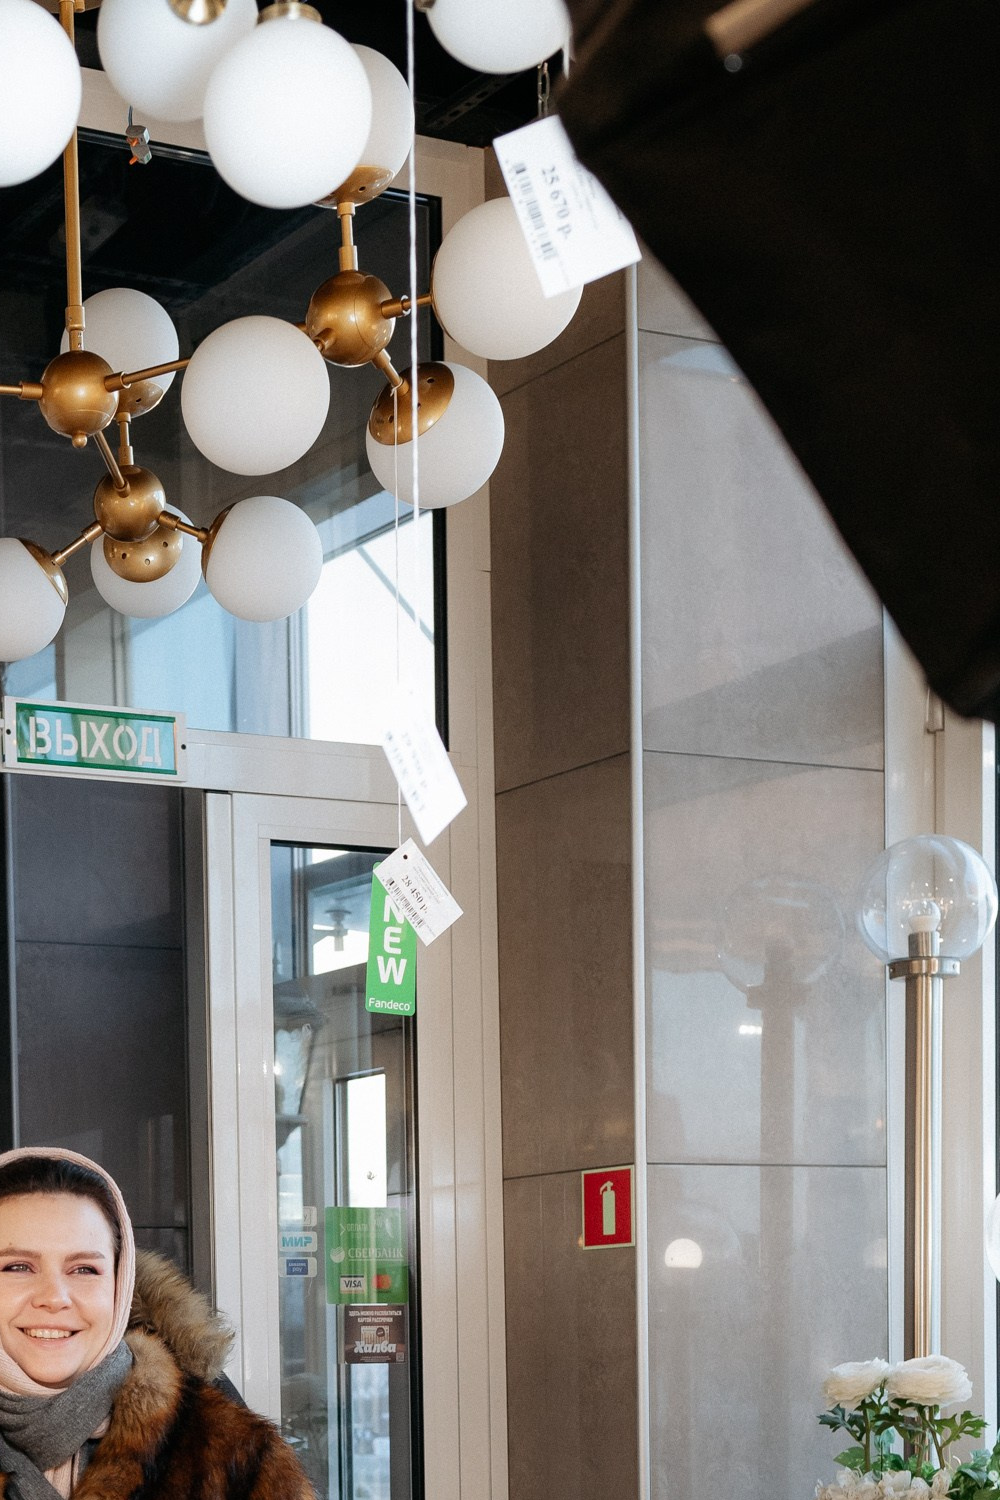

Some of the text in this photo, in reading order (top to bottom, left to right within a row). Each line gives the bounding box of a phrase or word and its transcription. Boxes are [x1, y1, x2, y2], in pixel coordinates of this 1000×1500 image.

[28, 716, 163, 767] ВЫХОД
[401, 875, 413, 888] 28
[410, 887, 424, 904] 450
[377, 895, 407, 985] NEW
[368, 997, 411, 1011] Fandeco
[281, 1236, 313, 1247] МИР
[347, 1247, 404, 1258] СБЕРБАНК
[343, 1280, 362, 1288] VISA
